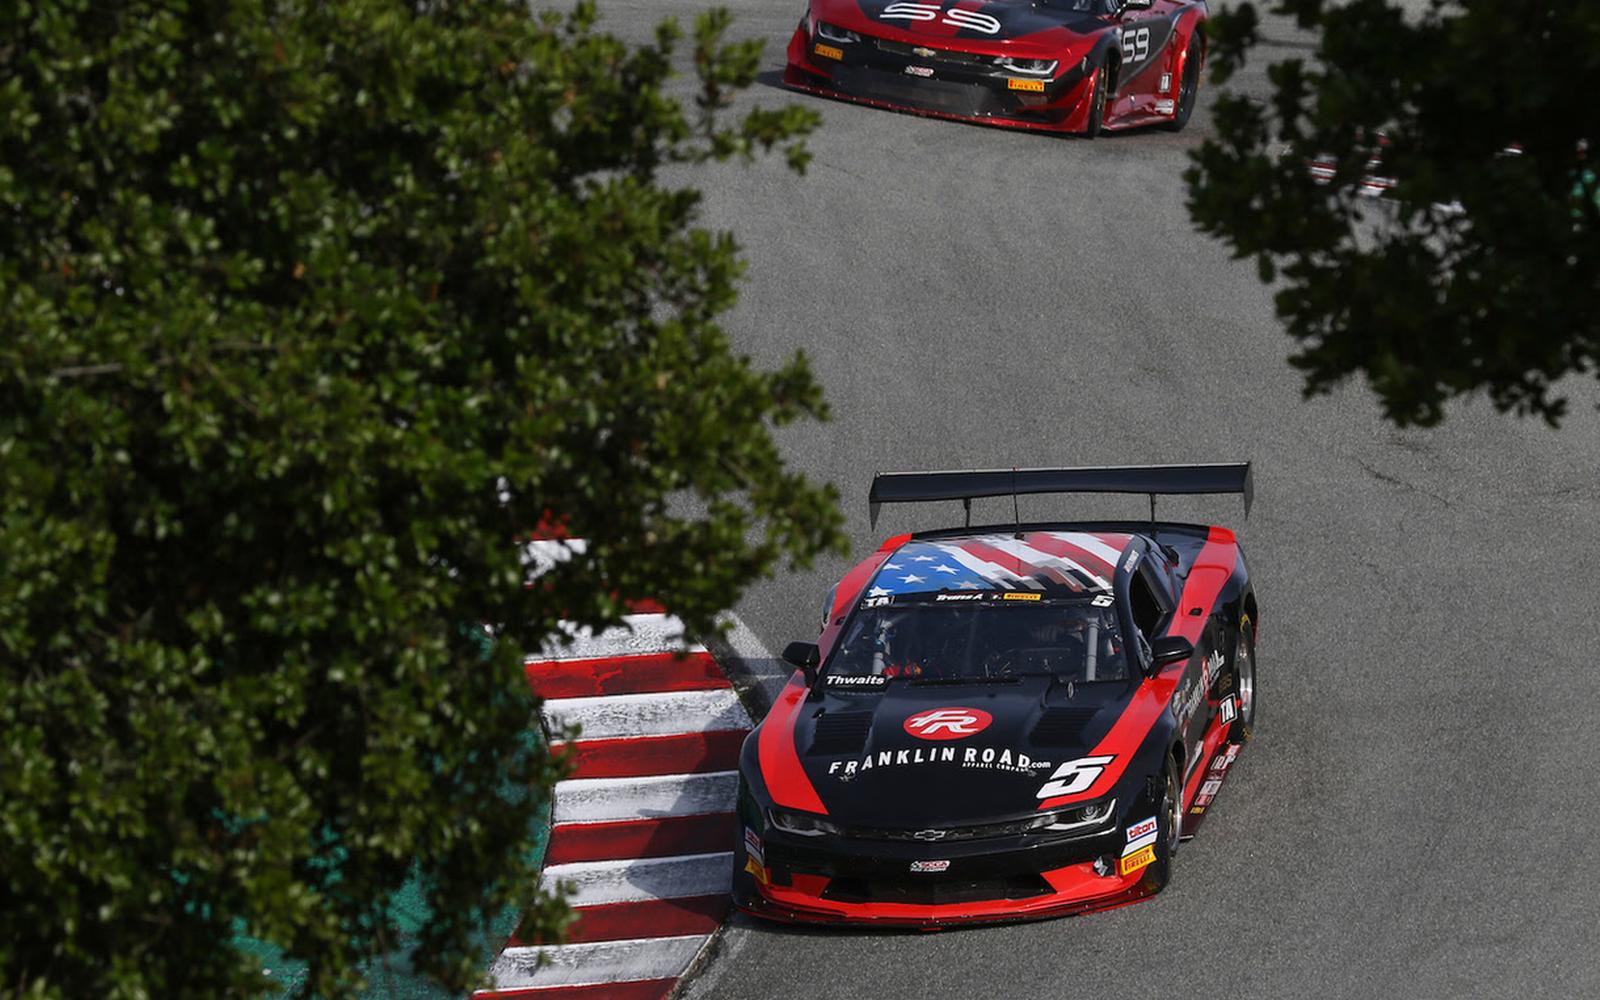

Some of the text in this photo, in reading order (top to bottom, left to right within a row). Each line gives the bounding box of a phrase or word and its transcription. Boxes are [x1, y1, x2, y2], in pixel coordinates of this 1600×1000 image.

[880, 2, 1001, 34] 59
[1122, 28, 1149, 64] 59
[827, 675, 884, 685] Thwaits
[828, 748, 955, 774] FRANKLIN
[964, 748, 1030, 768] ROAD
[1036, 755, 1114, 799] 5
[1124, 848, 1153, 872] PIRELLI
